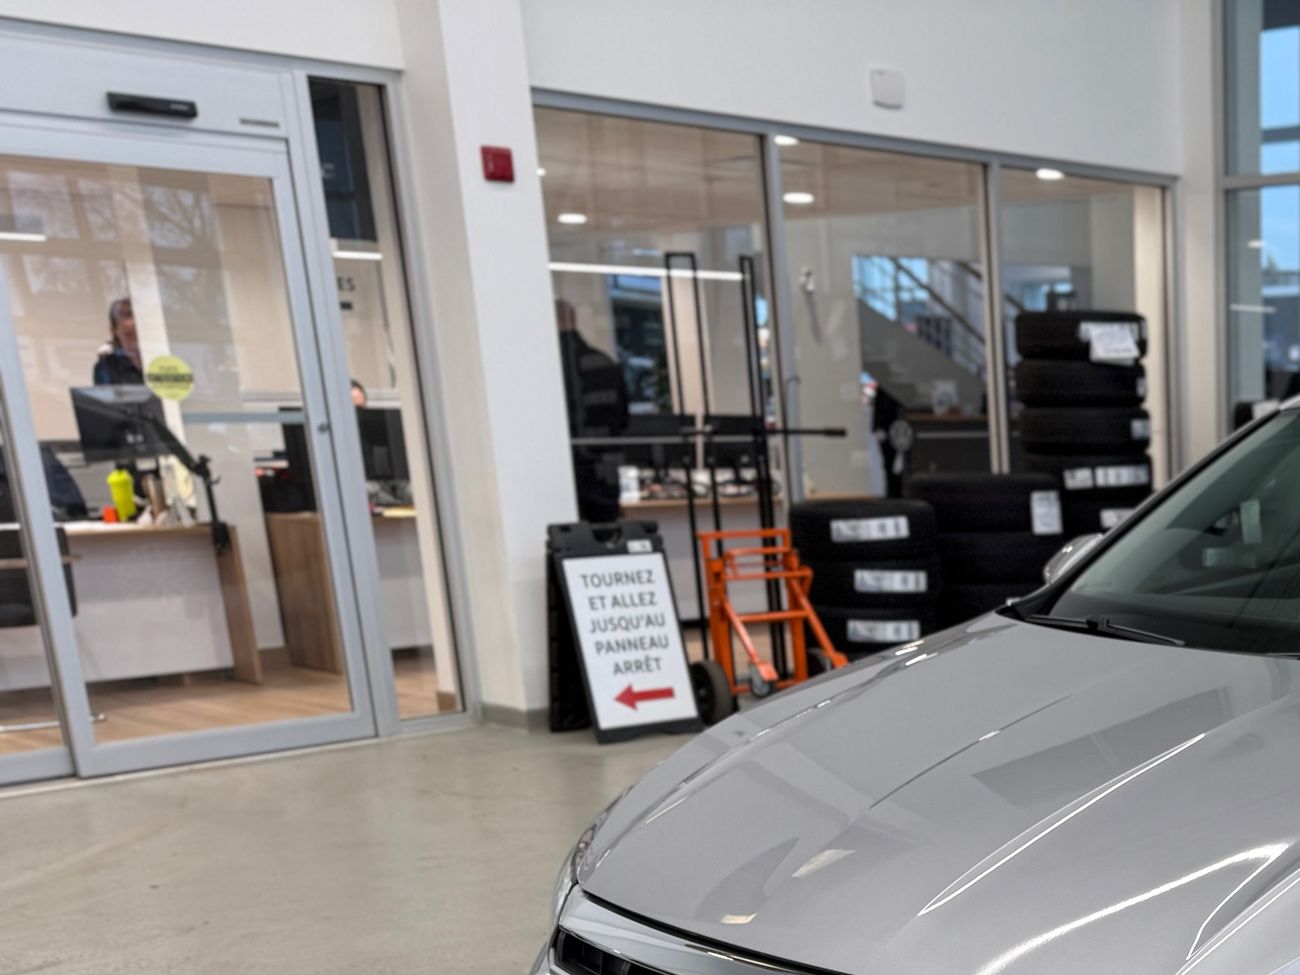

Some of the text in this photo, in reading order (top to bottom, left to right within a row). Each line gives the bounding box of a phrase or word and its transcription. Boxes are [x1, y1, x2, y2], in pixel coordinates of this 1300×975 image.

[580, 569, 655, 589] TOURNEZ
[588, 591, 657, 611] ET ALLEZ
[589, 613, 666, 634] JUSQU'AU
[594, 635, 669, 655] PANNEAU
[613, 655, 663, 676] ARRÊT
